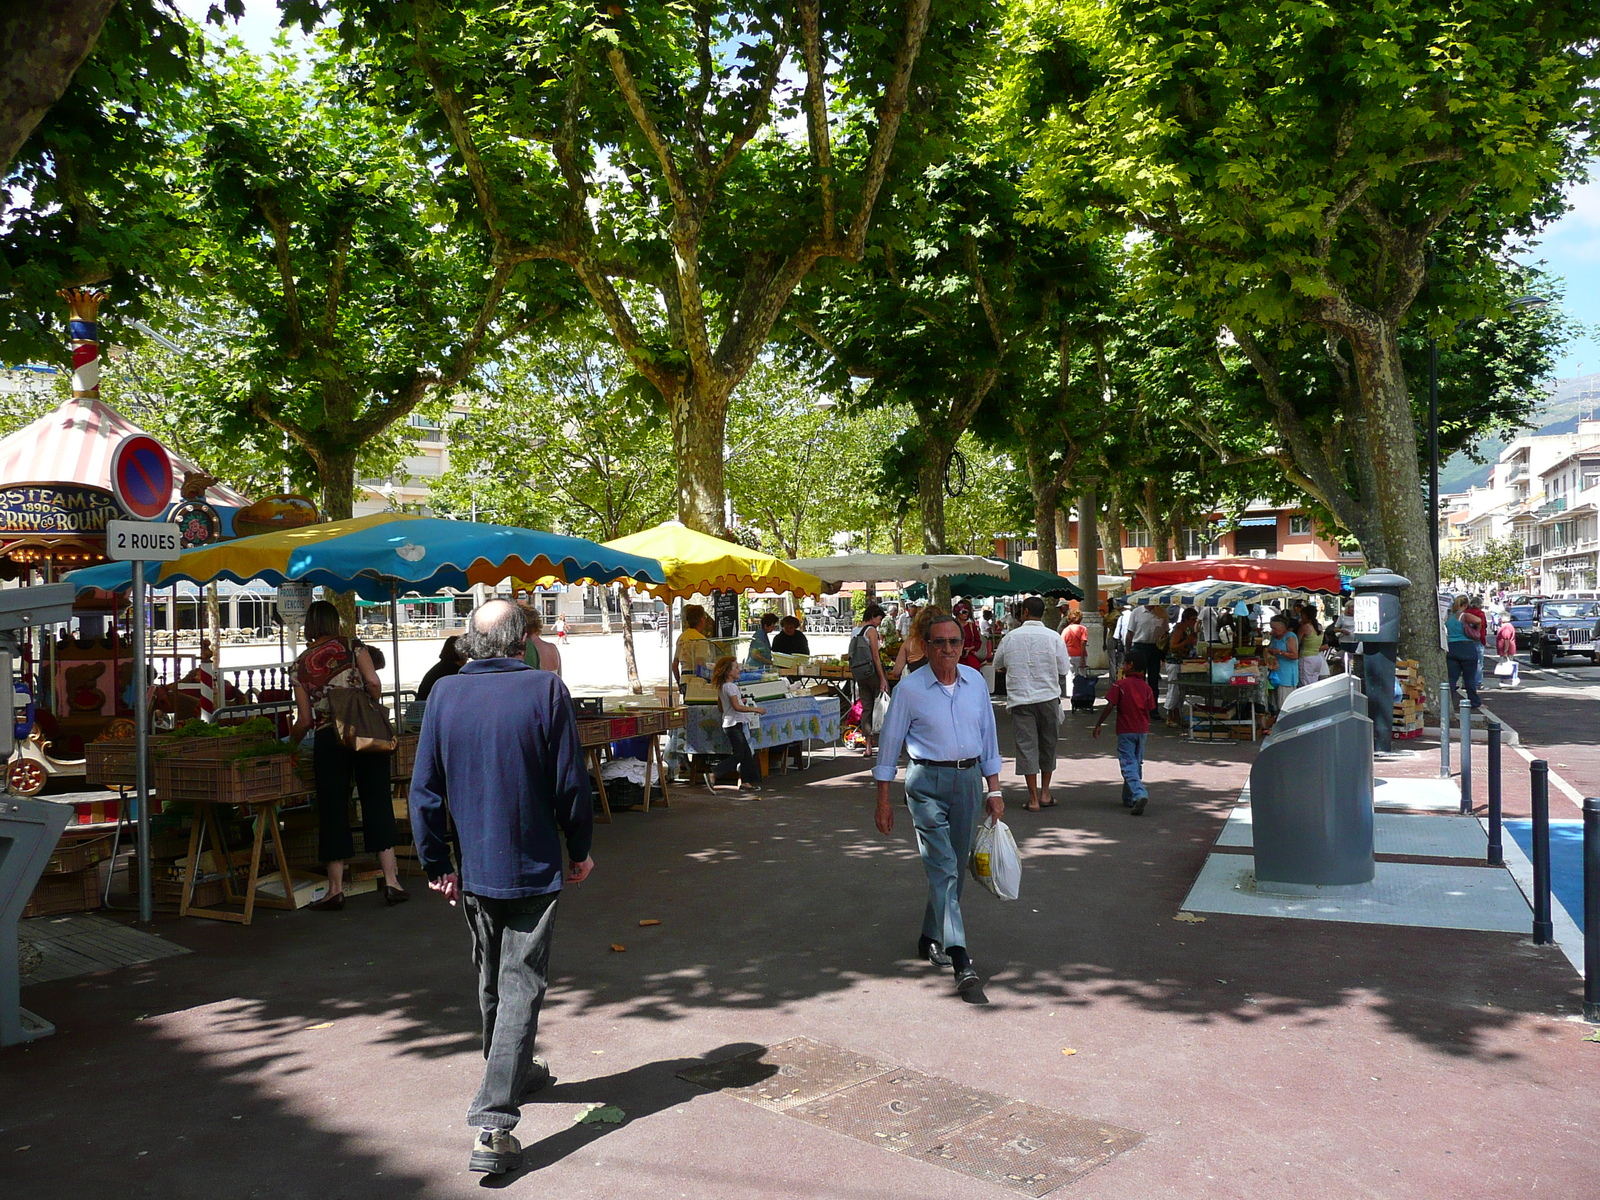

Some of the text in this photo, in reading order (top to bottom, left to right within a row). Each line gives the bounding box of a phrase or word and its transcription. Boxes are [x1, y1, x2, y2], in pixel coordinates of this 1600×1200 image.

[6, 488, 87, 509] STEAM
[22, 502, 49, 513] 1890
[41, 517, 54, 529] GO
[54, 505, 118, 531] ROUND
[118, 533, 175, 550] 2 ROUES
[280, 588, 309, 597] PRODUCTEUR
